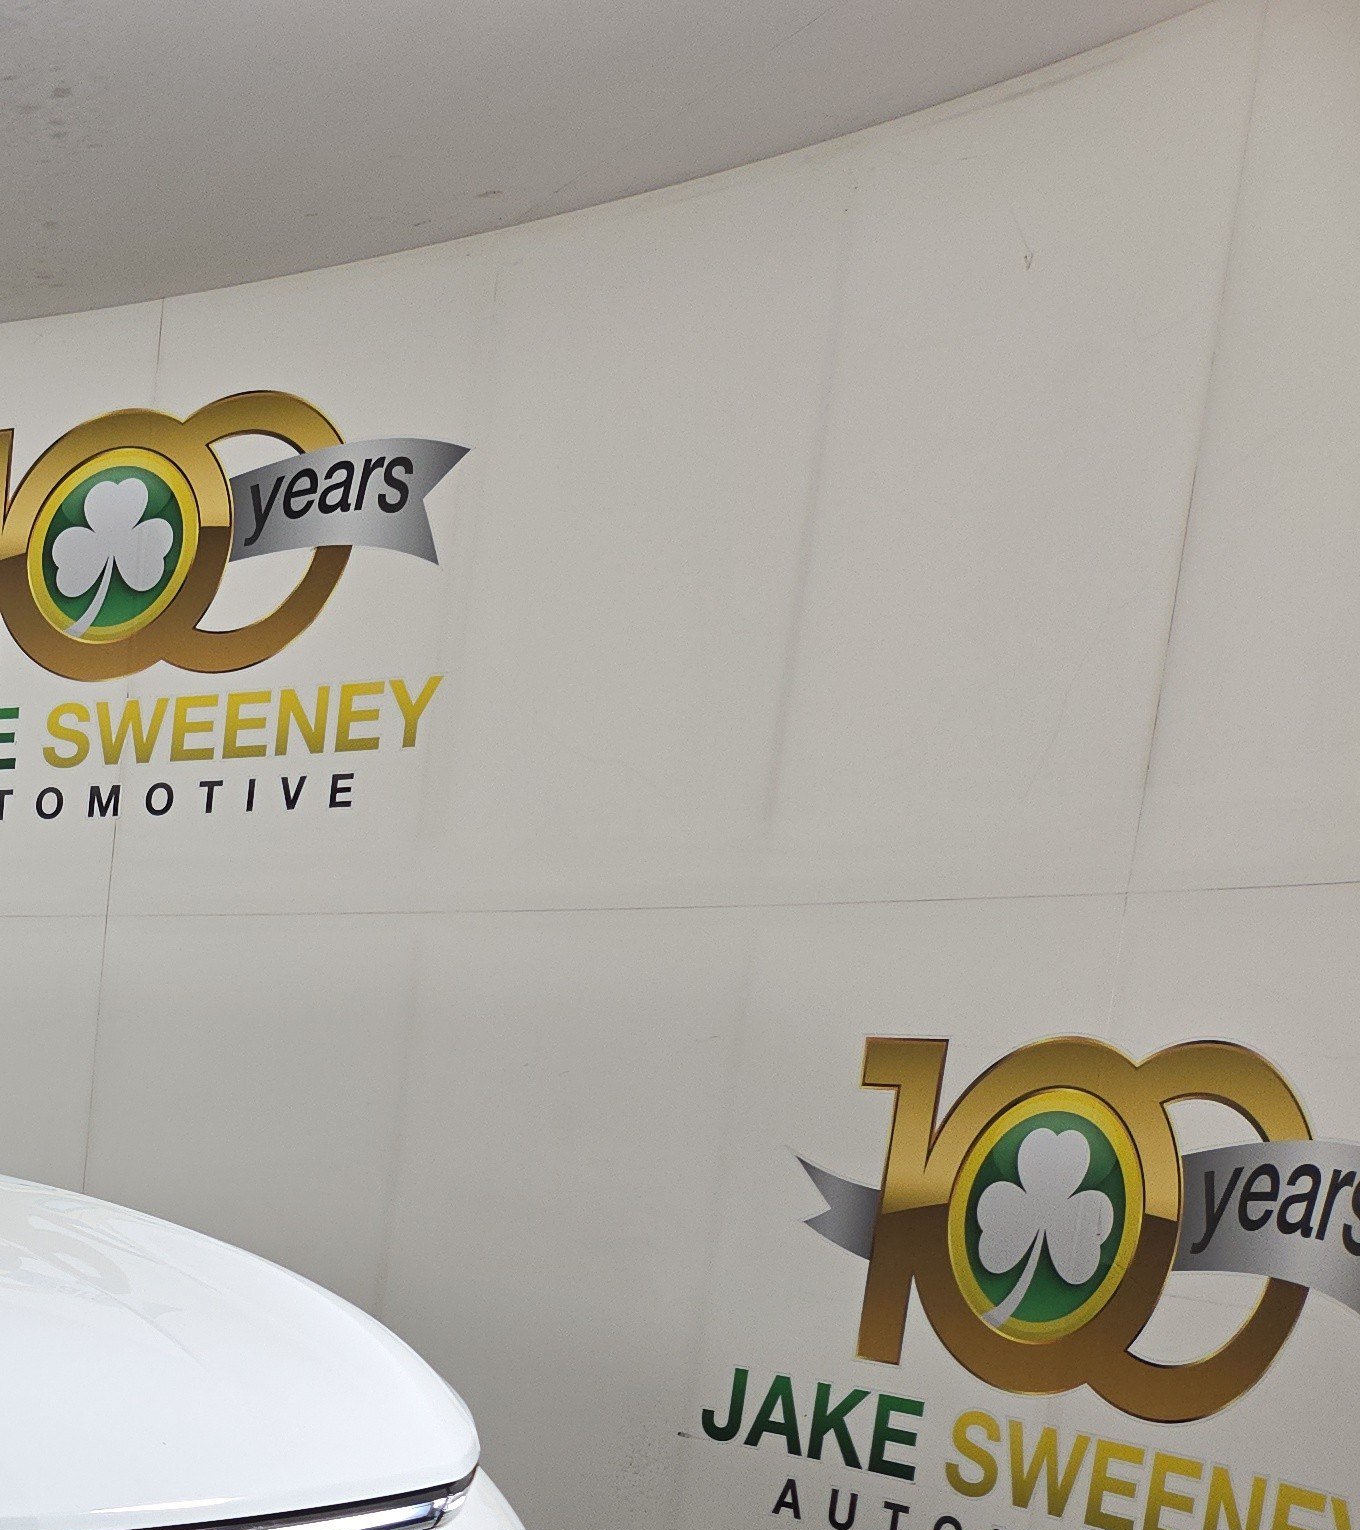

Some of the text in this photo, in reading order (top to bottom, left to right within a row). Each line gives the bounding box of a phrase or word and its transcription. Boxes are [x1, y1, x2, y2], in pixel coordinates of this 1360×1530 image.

[244, 455, 414, 545] years
[42, 675, 444, 769] SWEENEY
[855, 1036, 1312, 1424] 100
[701, 1368, 925, 1481] JAKE
